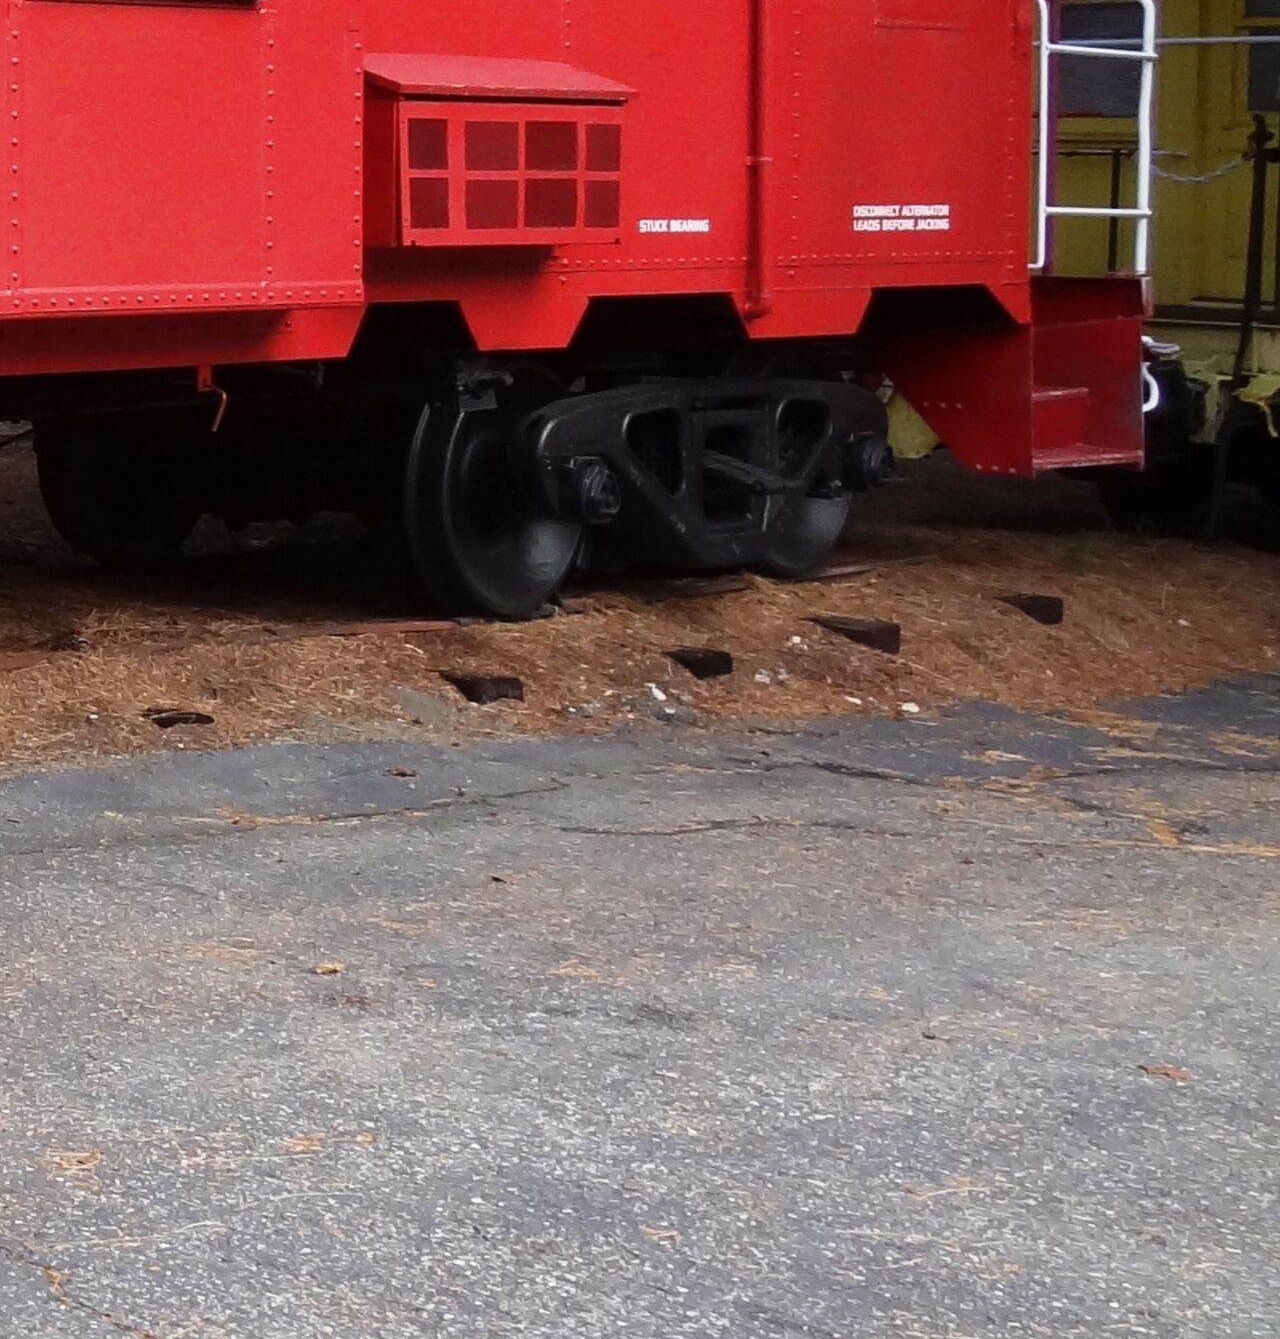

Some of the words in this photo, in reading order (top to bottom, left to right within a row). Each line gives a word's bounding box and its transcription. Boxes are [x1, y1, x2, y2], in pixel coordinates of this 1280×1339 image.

[639, 219, 669, 233] STUCK
[670, 219, 710, 232] BEARING
[853, 218, 880, 231] LEADS
[882, 218, 915, 231] BEFORE
[916, 218, 950, 230] JACKING
